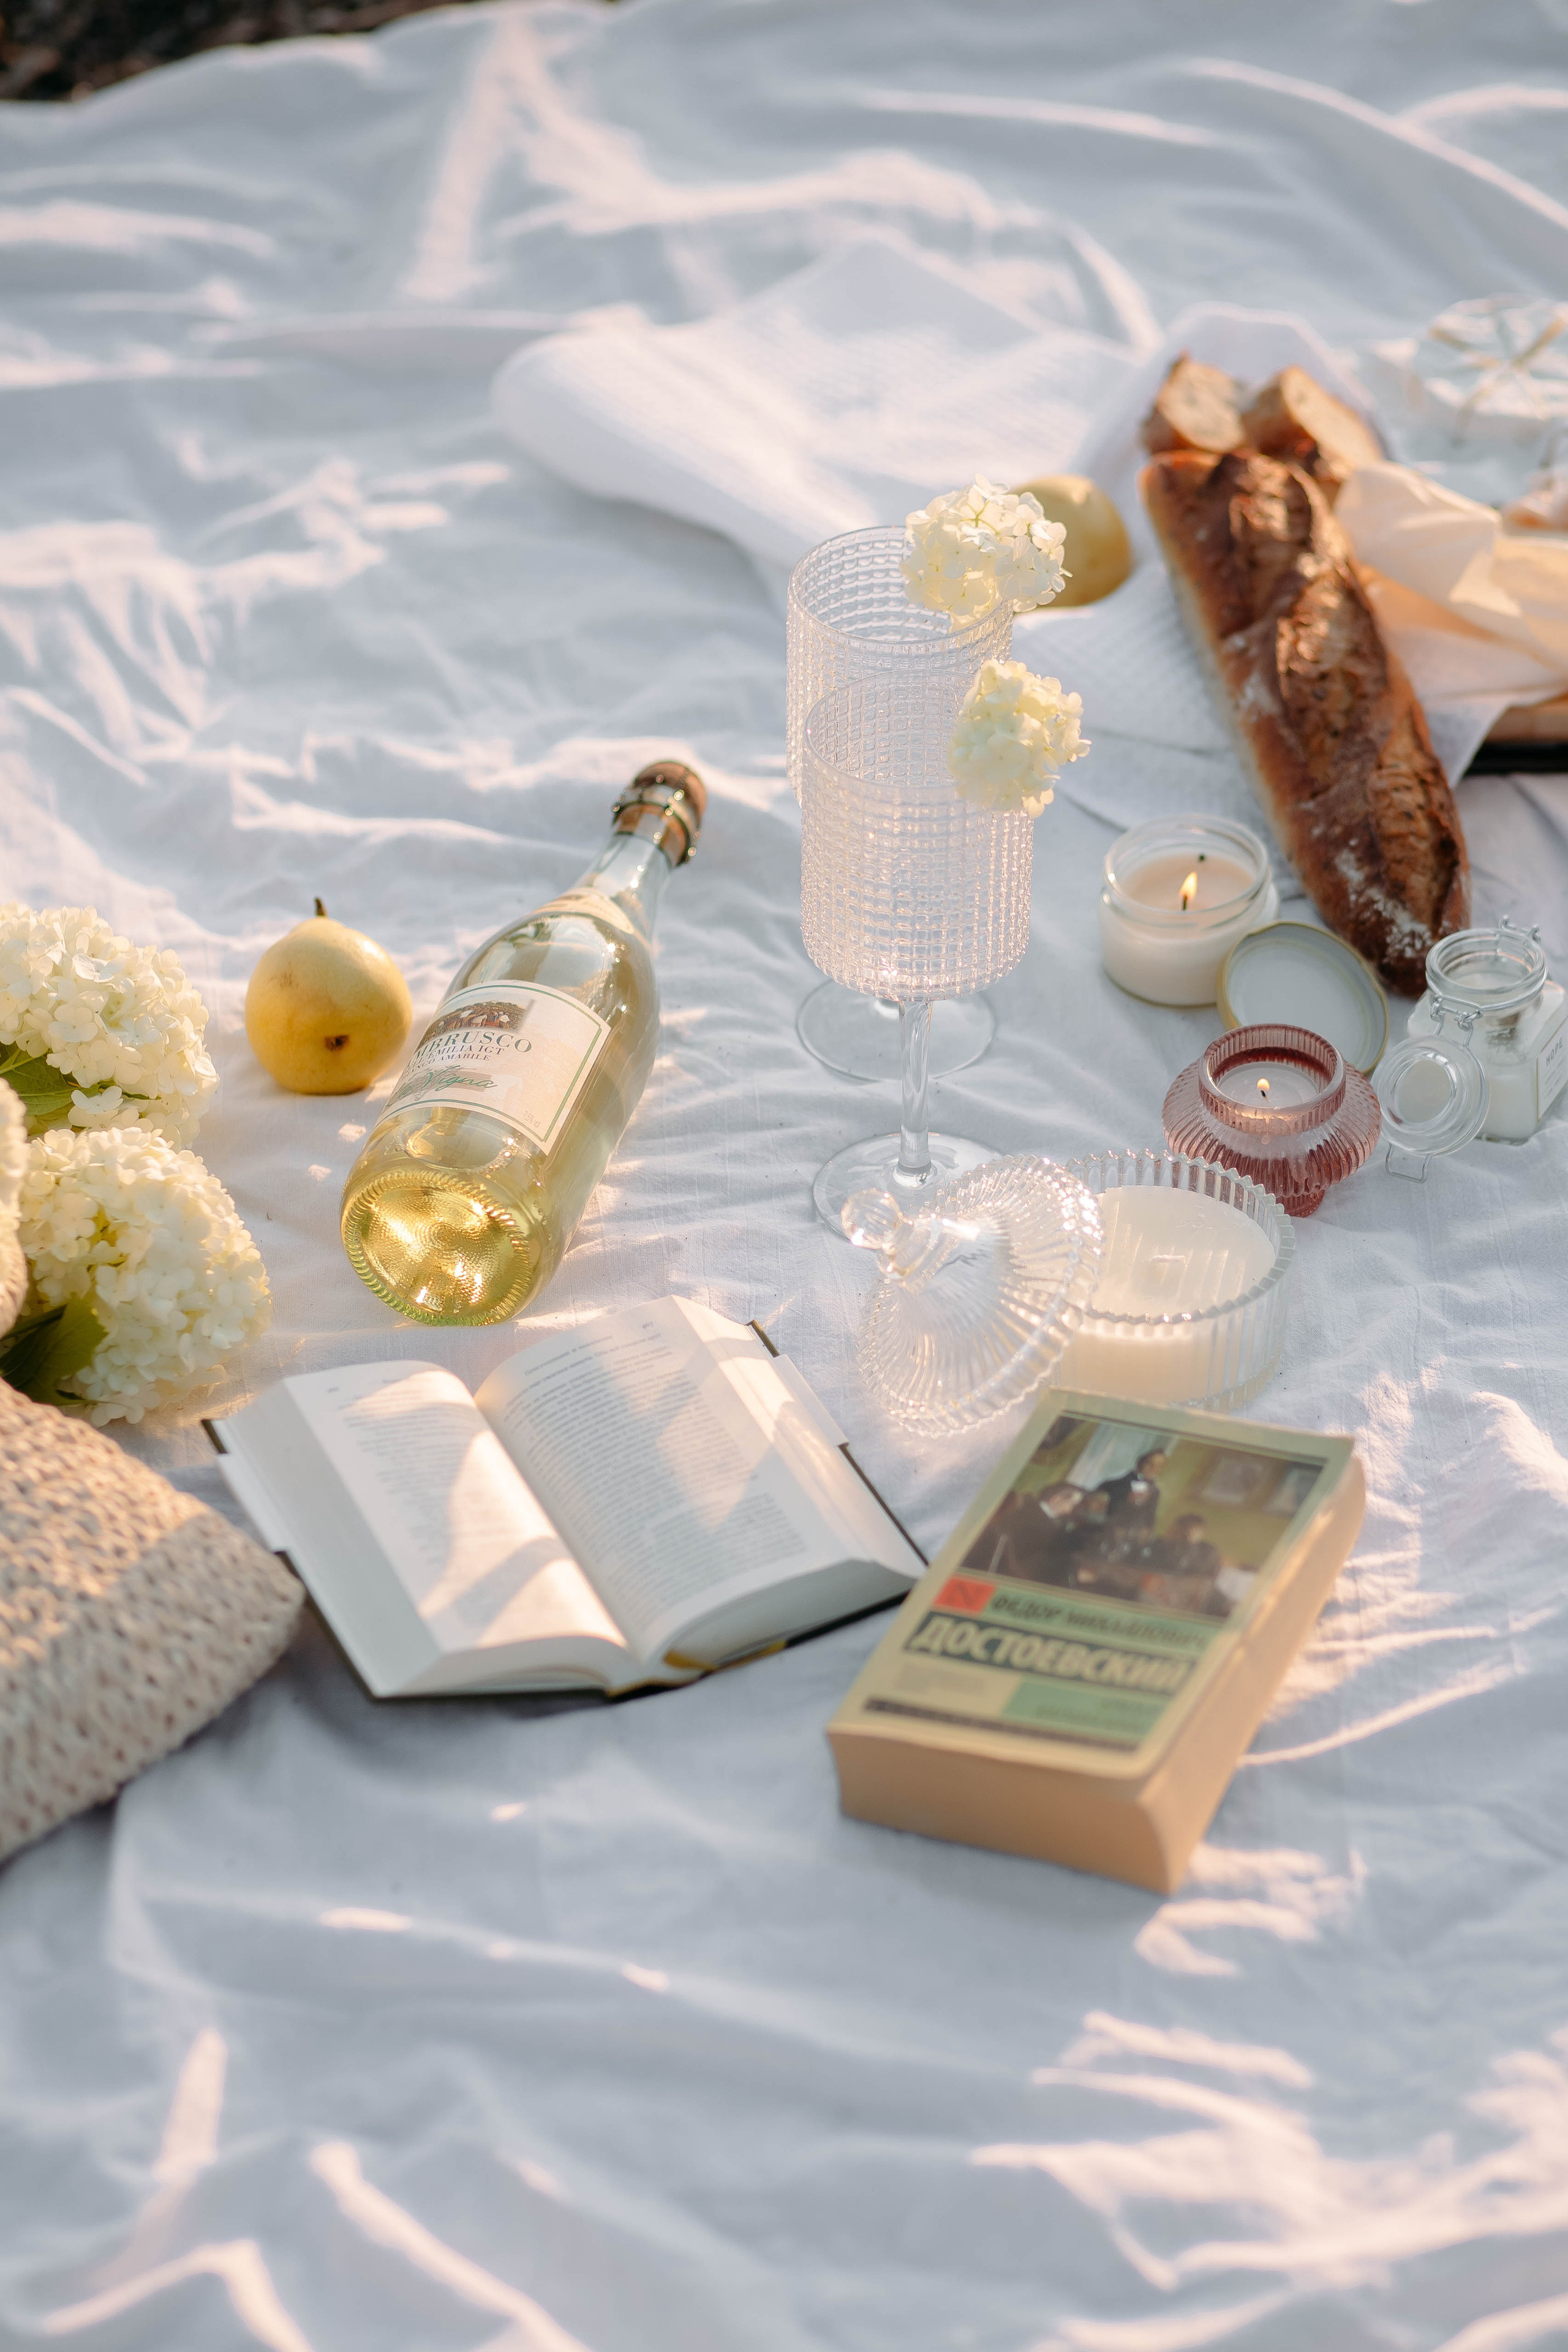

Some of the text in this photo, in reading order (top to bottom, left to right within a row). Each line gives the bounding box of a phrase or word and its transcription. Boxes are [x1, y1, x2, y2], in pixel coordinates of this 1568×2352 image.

[406, 1031, 532, 1068] MBRUSCO
[438, 1053, 491, 1061] AMABILE
[478, 1044, 505, 1055] IGT
[1546, 1037, 1563, 1067] HOPE
[423, 1065, 498, 1092] Vigna
